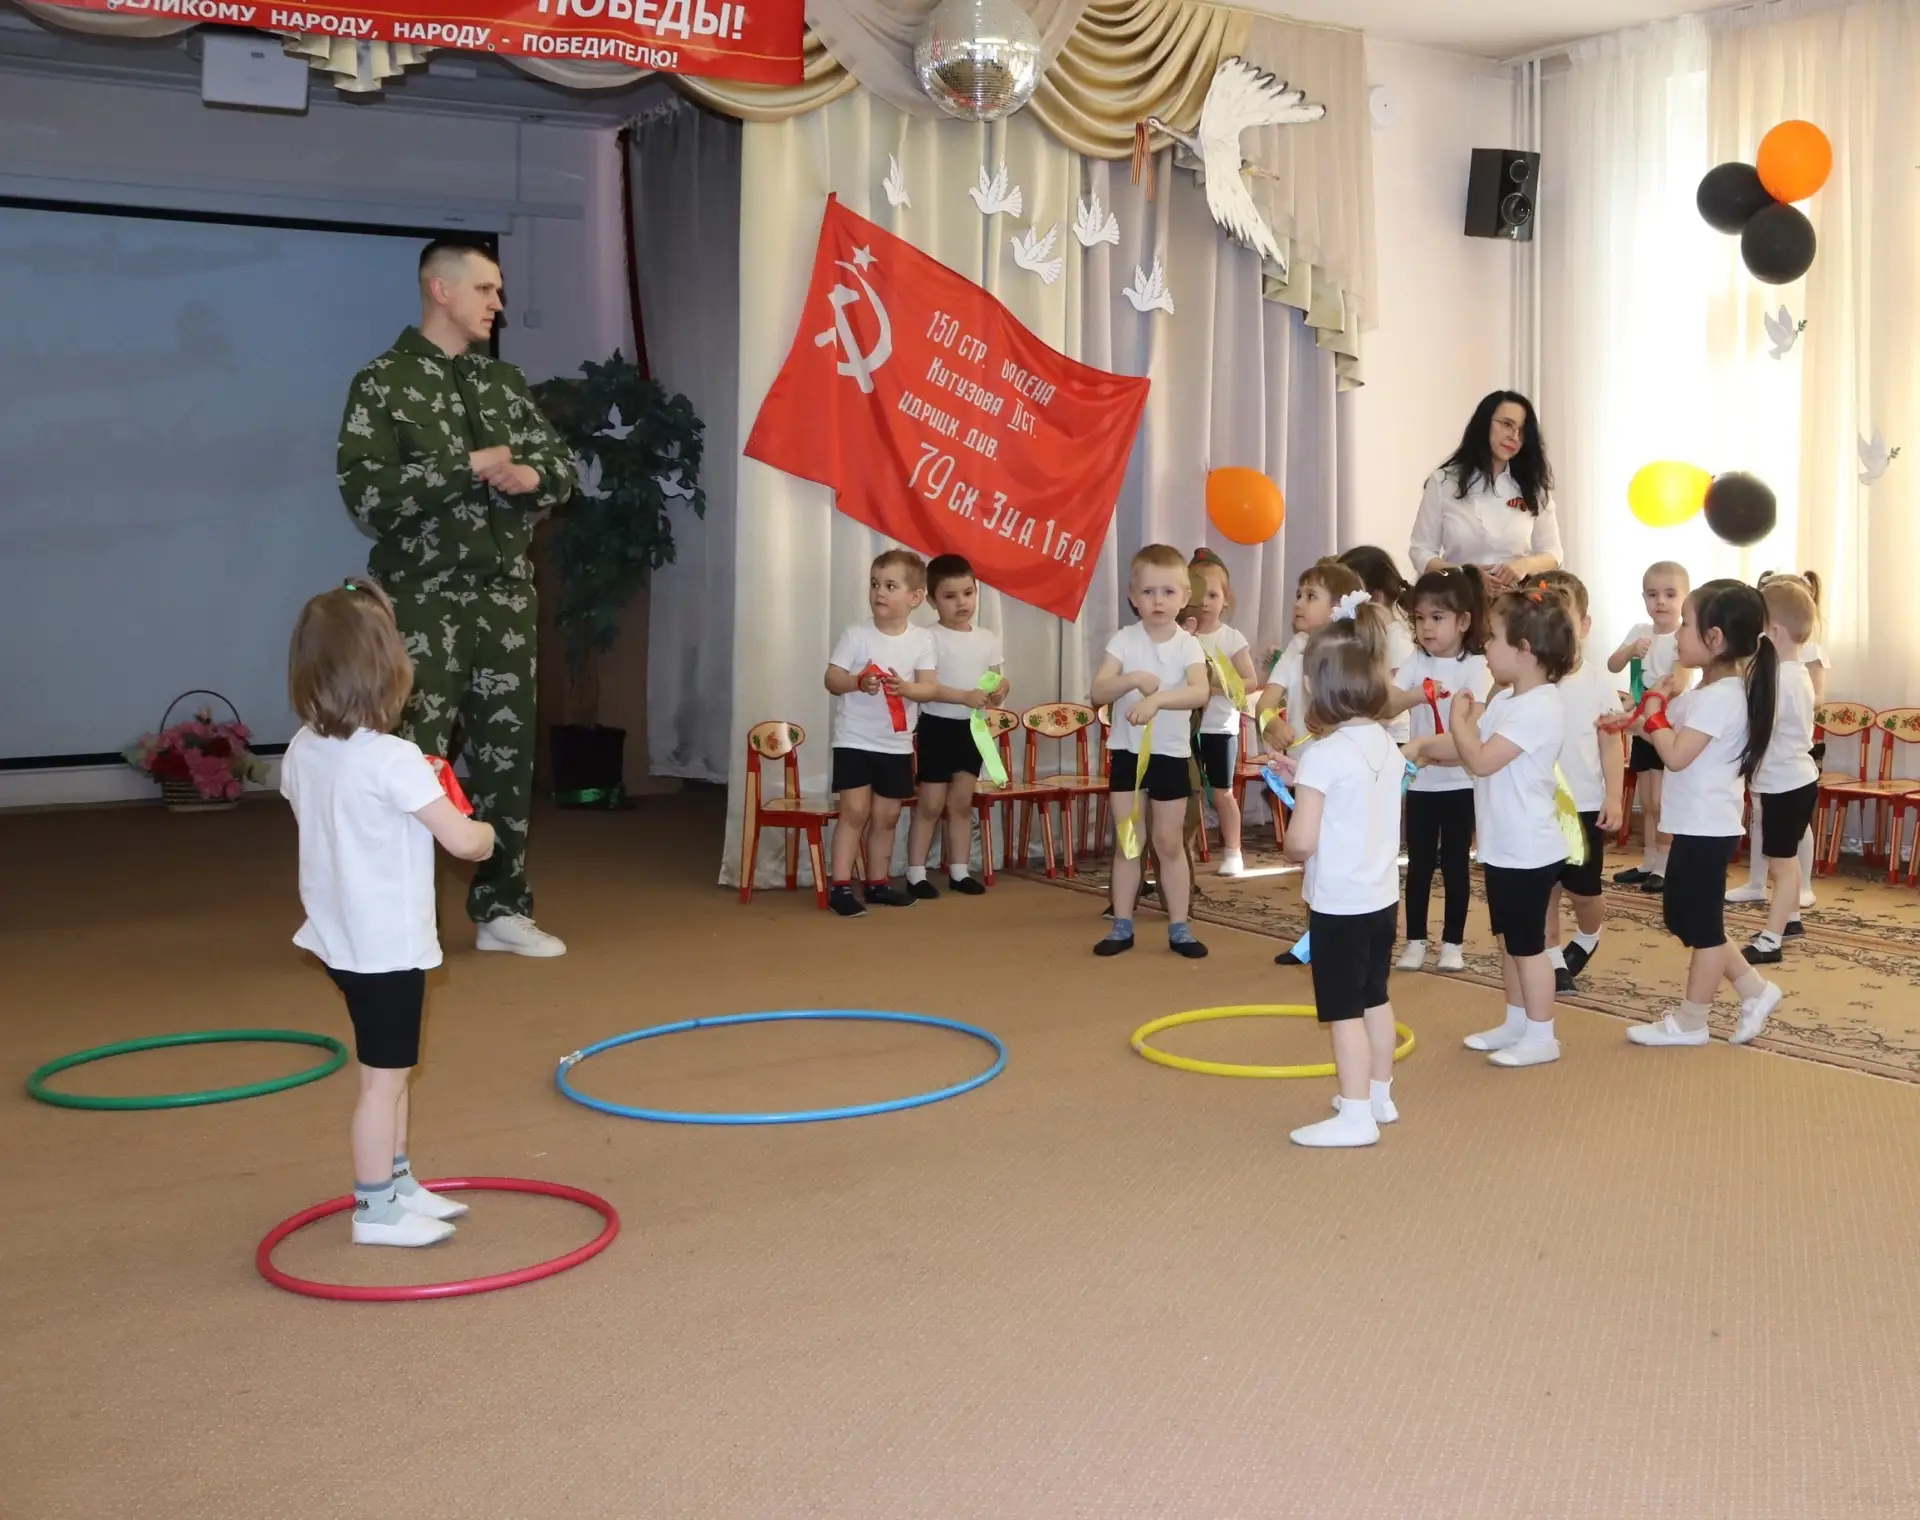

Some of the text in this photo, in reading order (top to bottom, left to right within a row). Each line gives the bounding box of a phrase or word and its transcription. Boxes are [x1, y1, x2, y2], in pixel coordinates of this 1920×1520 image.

[271, 9, 379, 39] НАРОДУ,
[522, 33, 679, 69] ПОБЕДИТЕЛЮ!
[926, 310, 1057, 407] 150 СТР. ОРДЕНА
[908, 441, 956, 499] 79
[948, 481, 980, 521] СК.
